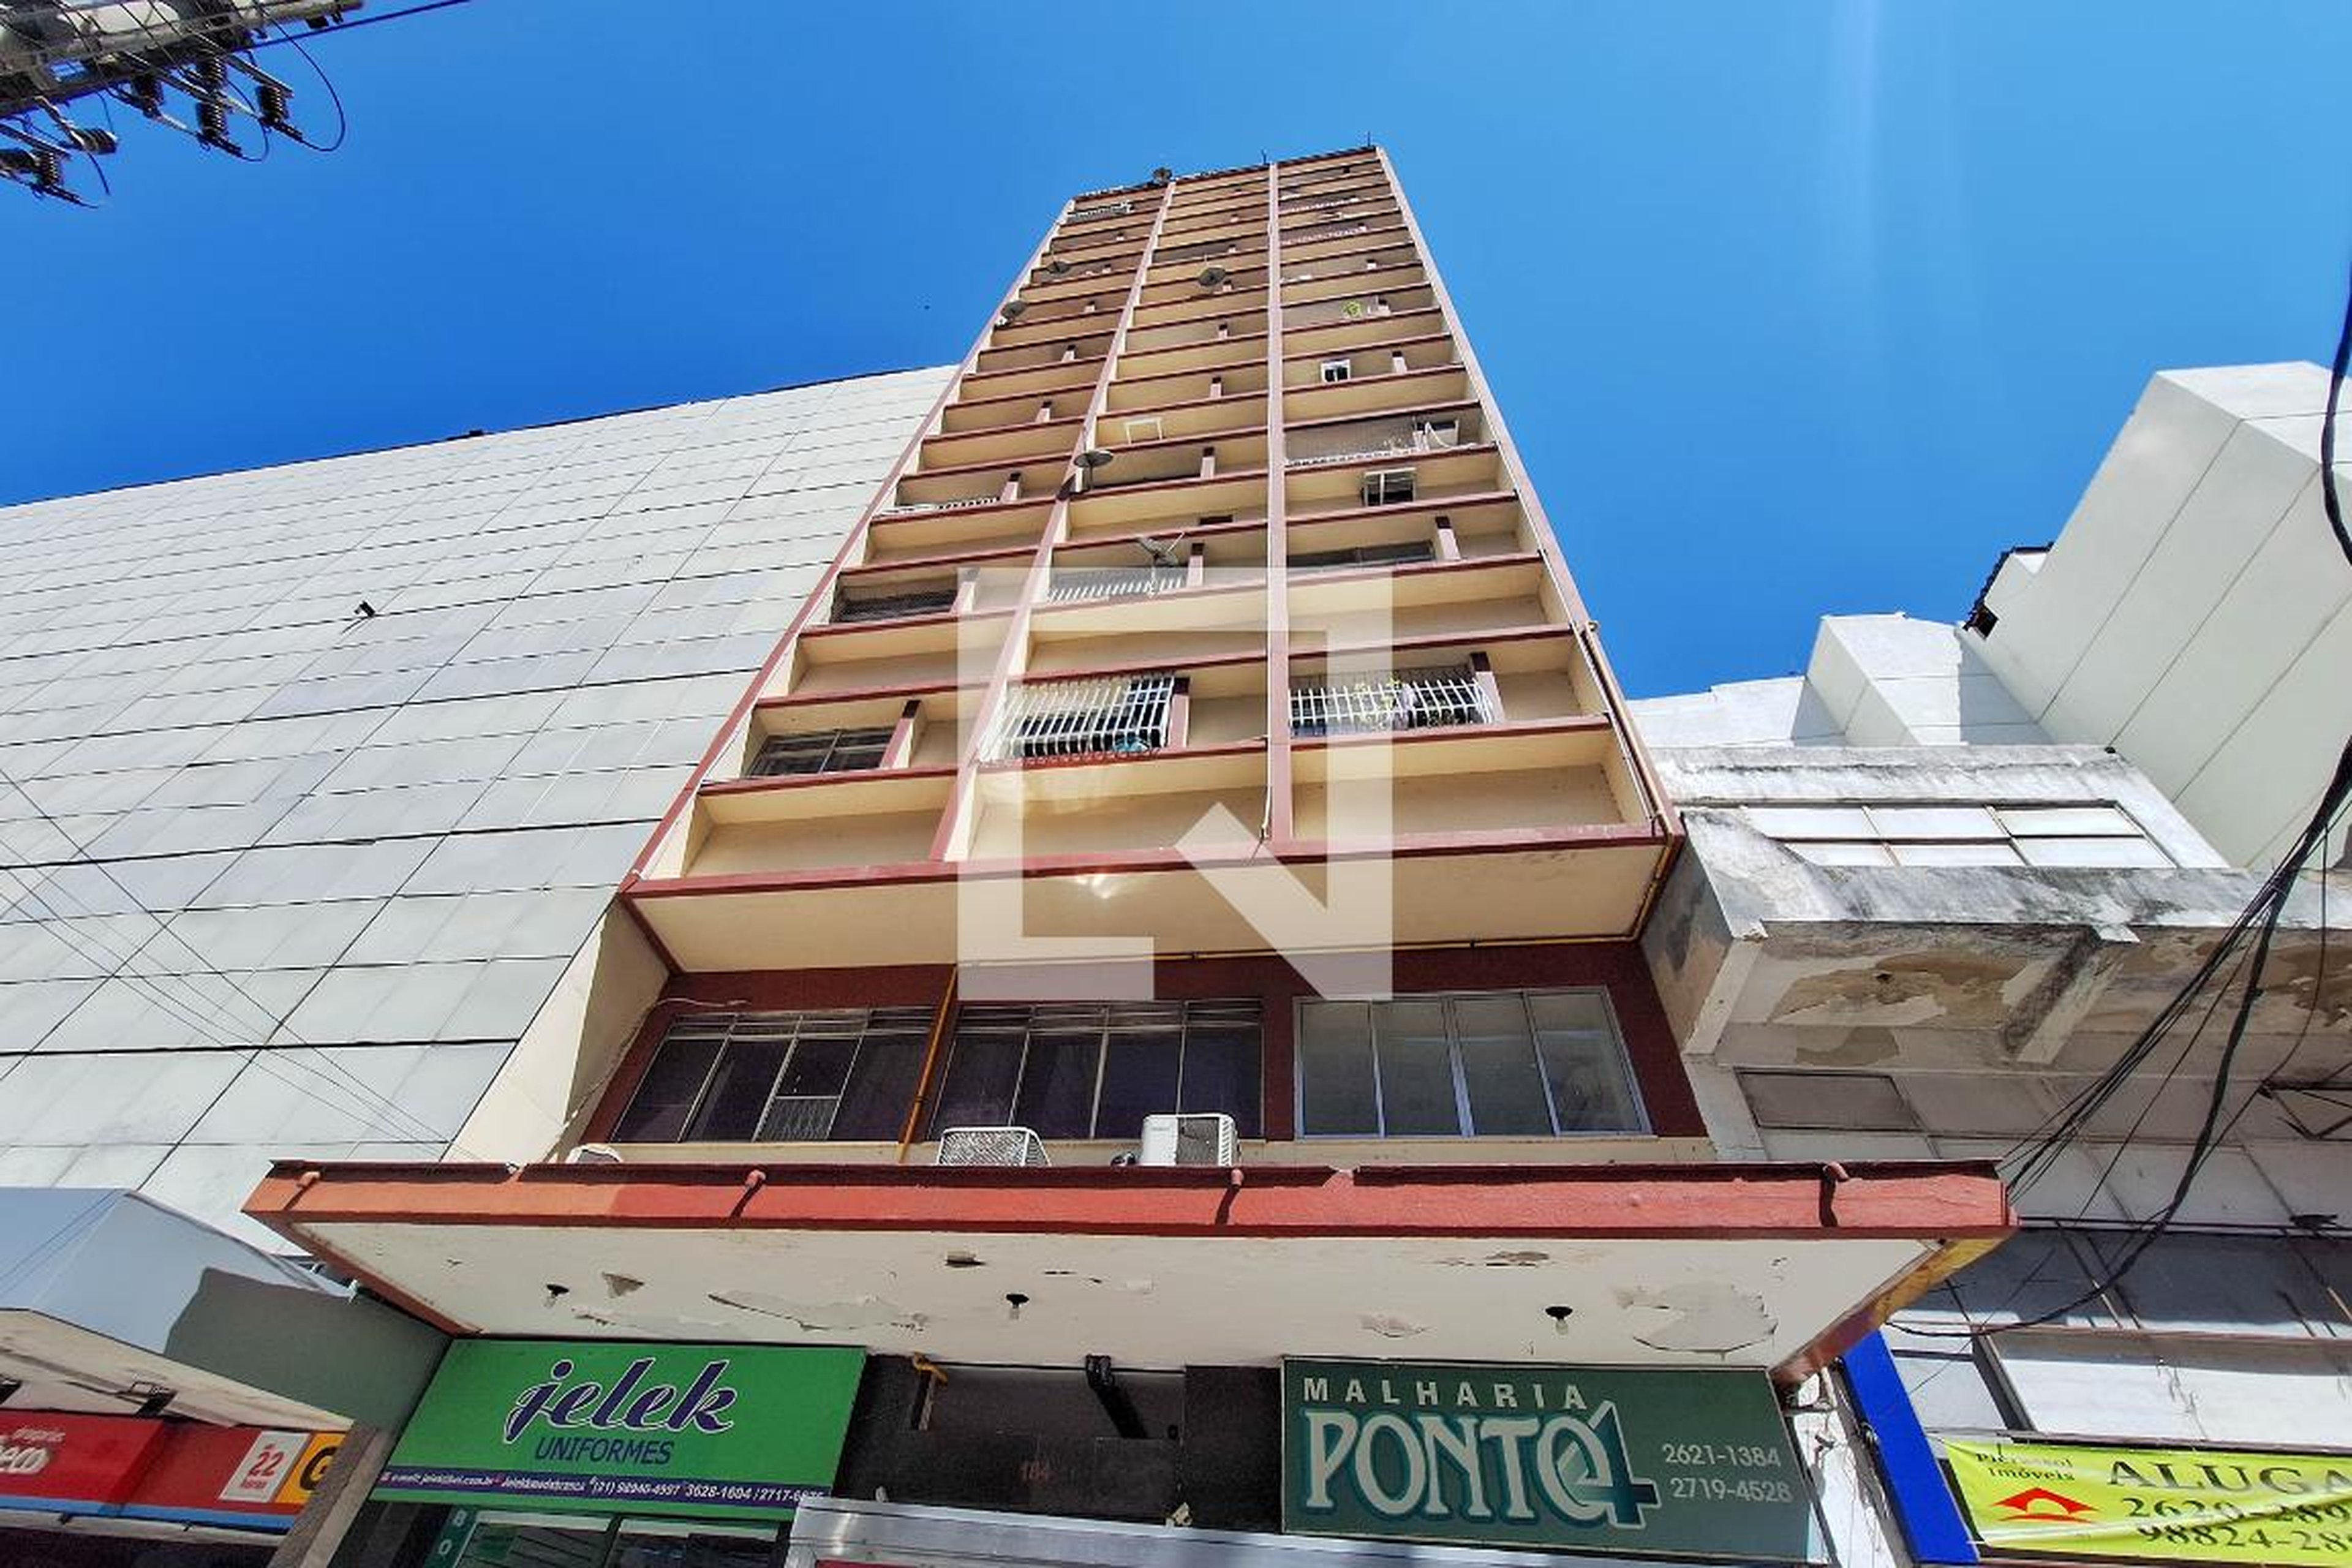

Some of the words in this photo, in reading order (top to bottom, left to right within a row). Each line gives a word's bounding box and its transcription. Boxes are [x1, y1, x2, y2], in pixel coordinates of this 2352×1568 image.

[504, 1357, 737, 1444] jelek
[1303, 1378, 1587, 1409] MALHARIA
[534, 1436, 674, 1464] UNIFORMES
[1662, 1443, 1782, 1467] 2621-1384
[248, 1451, 285, 1477] 22
[1670, 1477, 1793, 1502] 2719-4528
